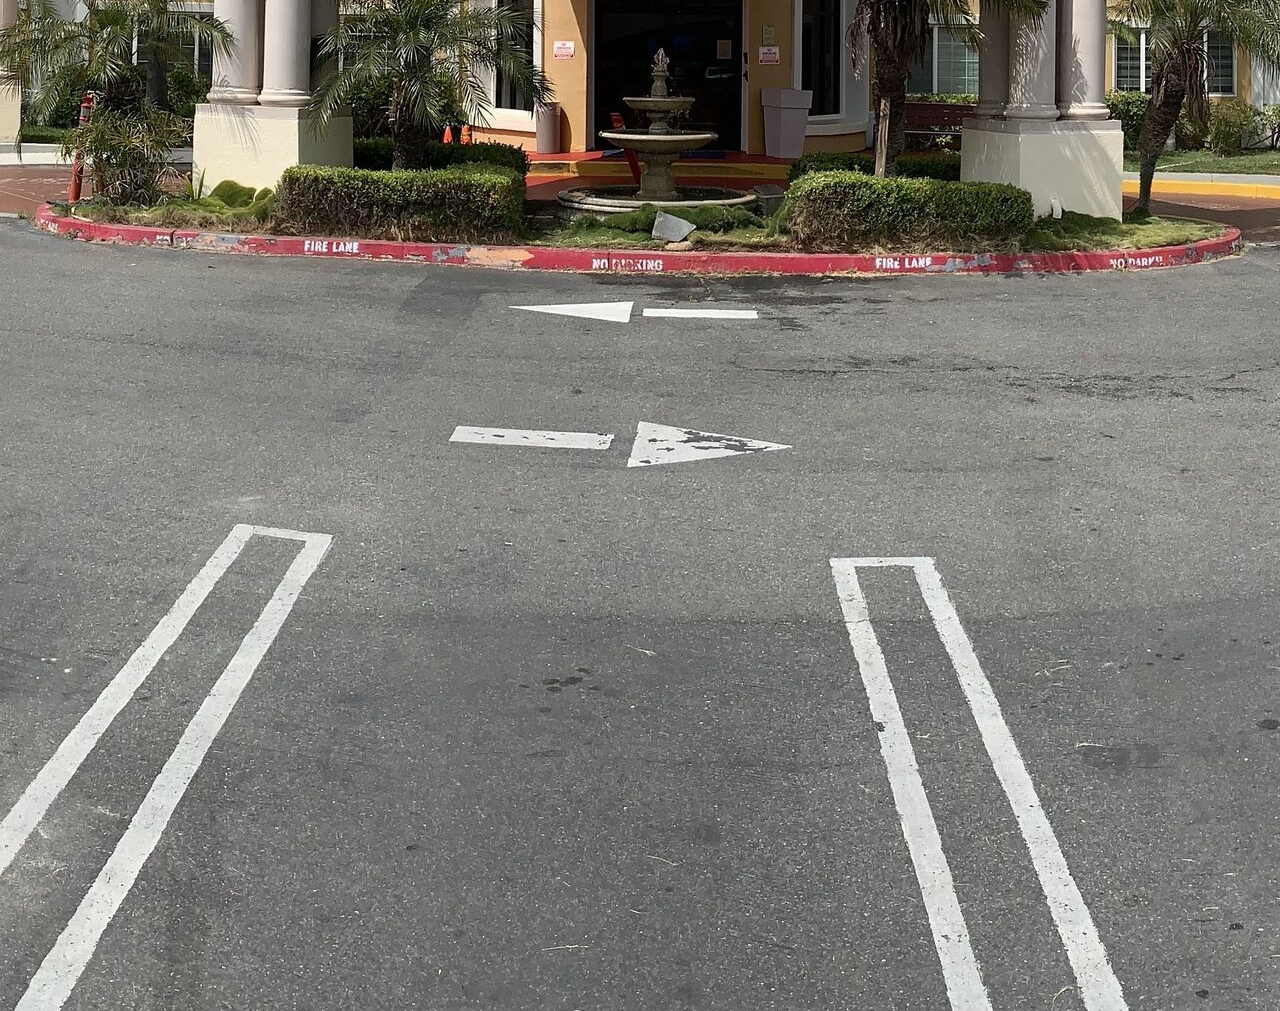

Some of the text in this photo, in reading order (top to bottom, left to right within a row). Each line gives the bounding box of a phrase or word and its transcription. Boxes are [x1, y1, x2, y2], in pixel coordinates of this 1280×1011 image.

[304, 240, 360, 254] FIRE LANE
[592, 258, 609, 270] NO
[875, 256, 932, 269] FIRE LANE
